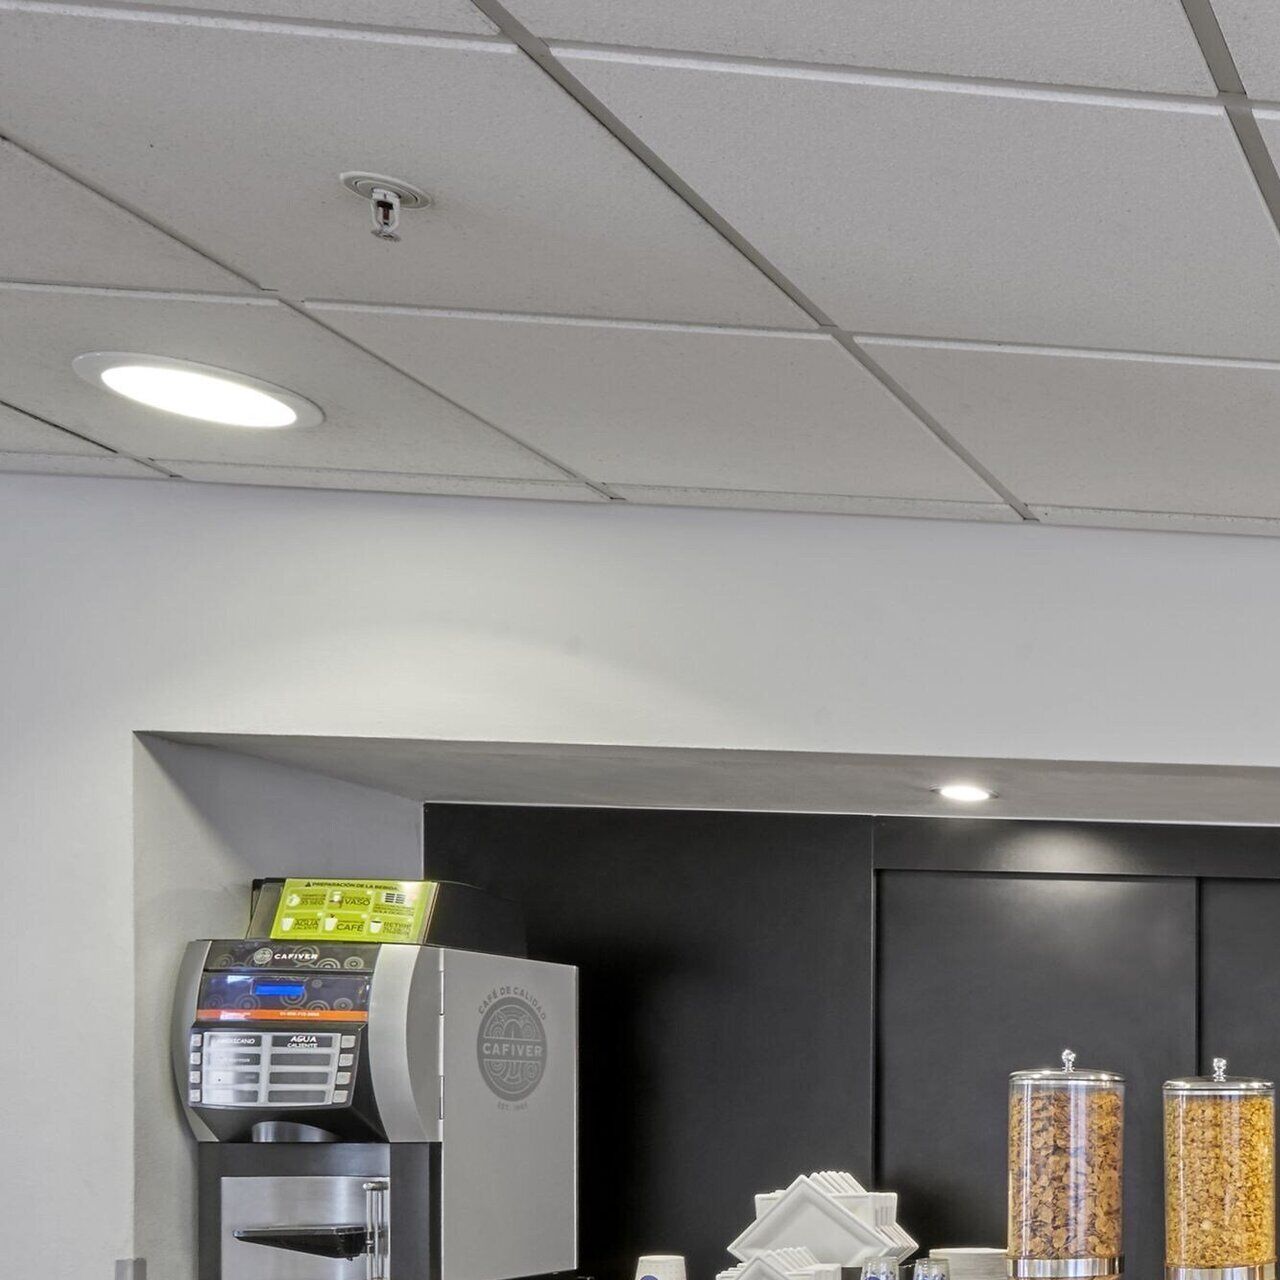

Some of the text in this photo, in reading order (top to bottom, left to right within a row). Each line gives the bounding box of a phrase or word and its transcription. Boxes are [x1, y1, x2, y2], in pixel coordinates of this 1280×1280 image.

[344, 896, 371, 906] VASO
[336, 922, 364, 932] CAFÉ
[478, 986, 547, 1021] CAFÉ DE CALIDAD
[290, 1035, 317, 1043] AGUA
[482, 1042, 543, 1057] CAFIVER
